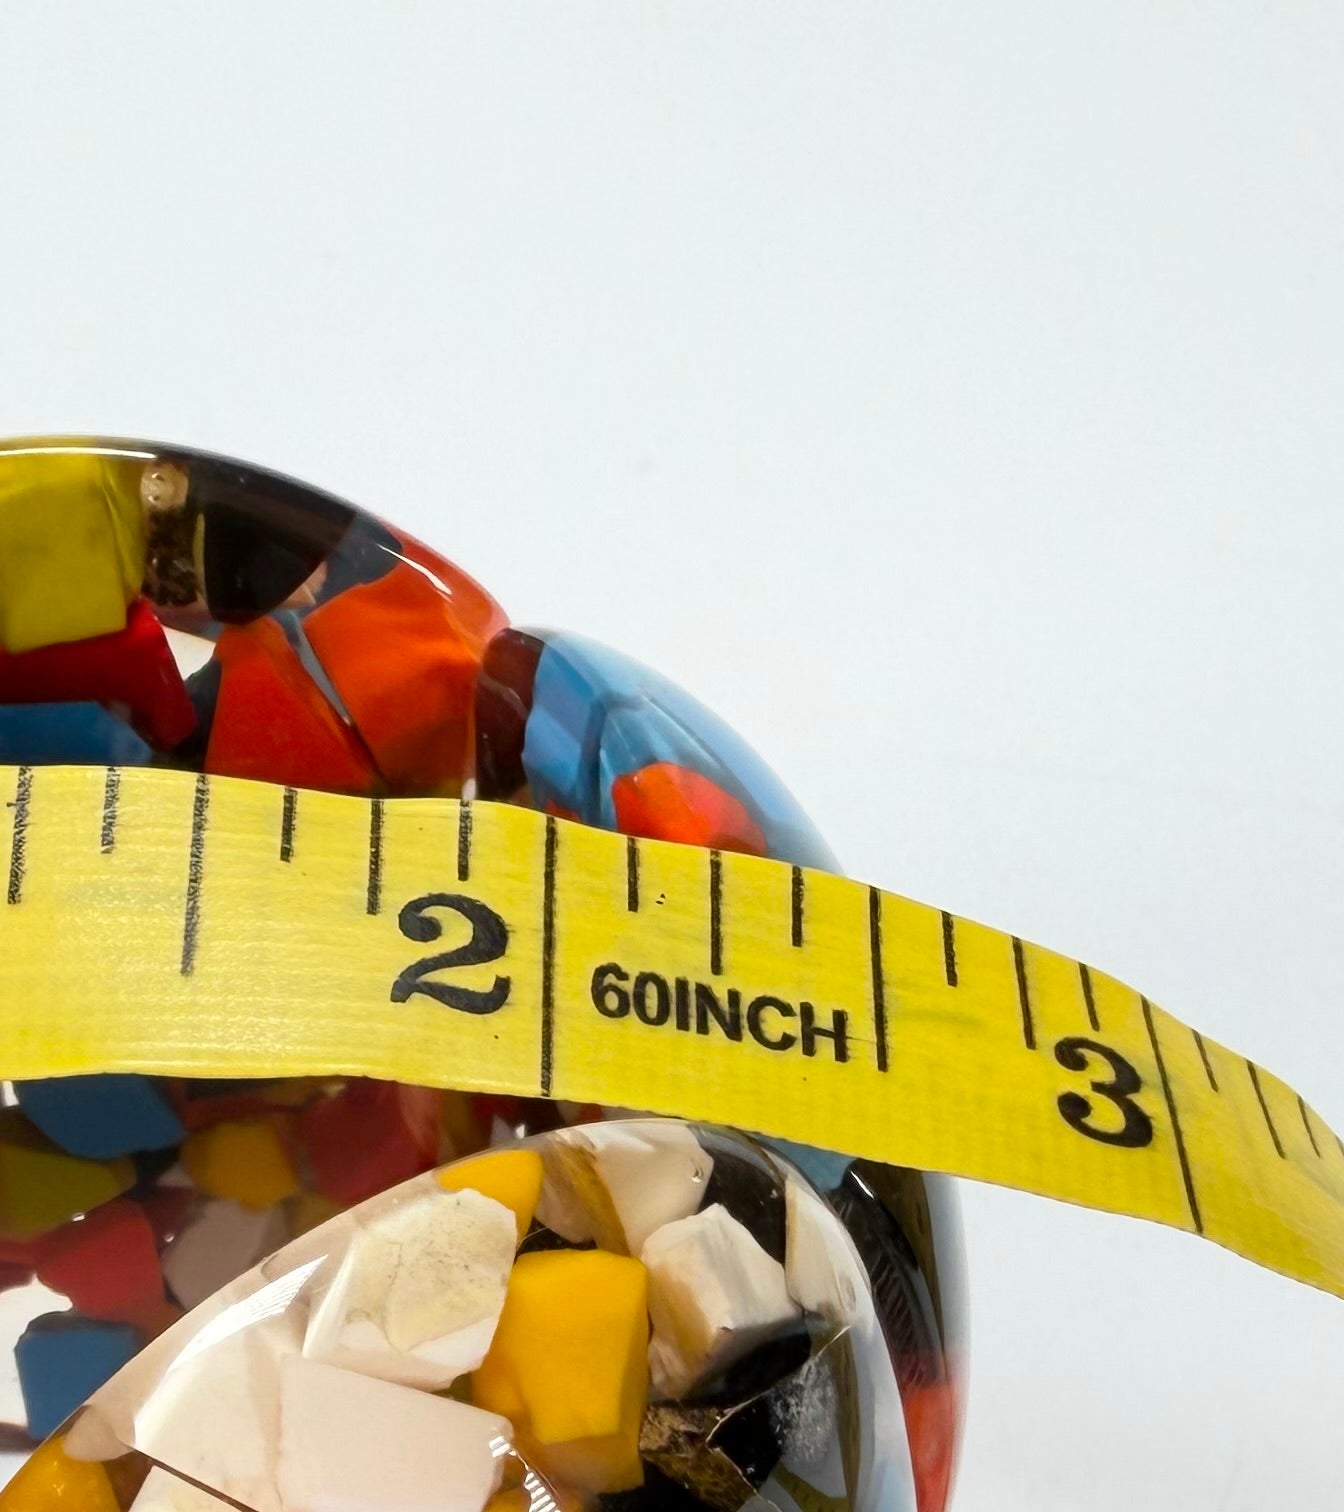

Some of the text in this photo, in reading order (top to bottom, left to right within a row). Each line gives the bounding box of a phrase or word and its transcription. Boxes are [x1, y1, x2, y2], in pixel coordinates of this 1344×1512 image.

[390, 892, 512, 1014] 2
[590, 962, 850, 1065] 60INCH
[1053, 1037, 1155, 1149] 3
